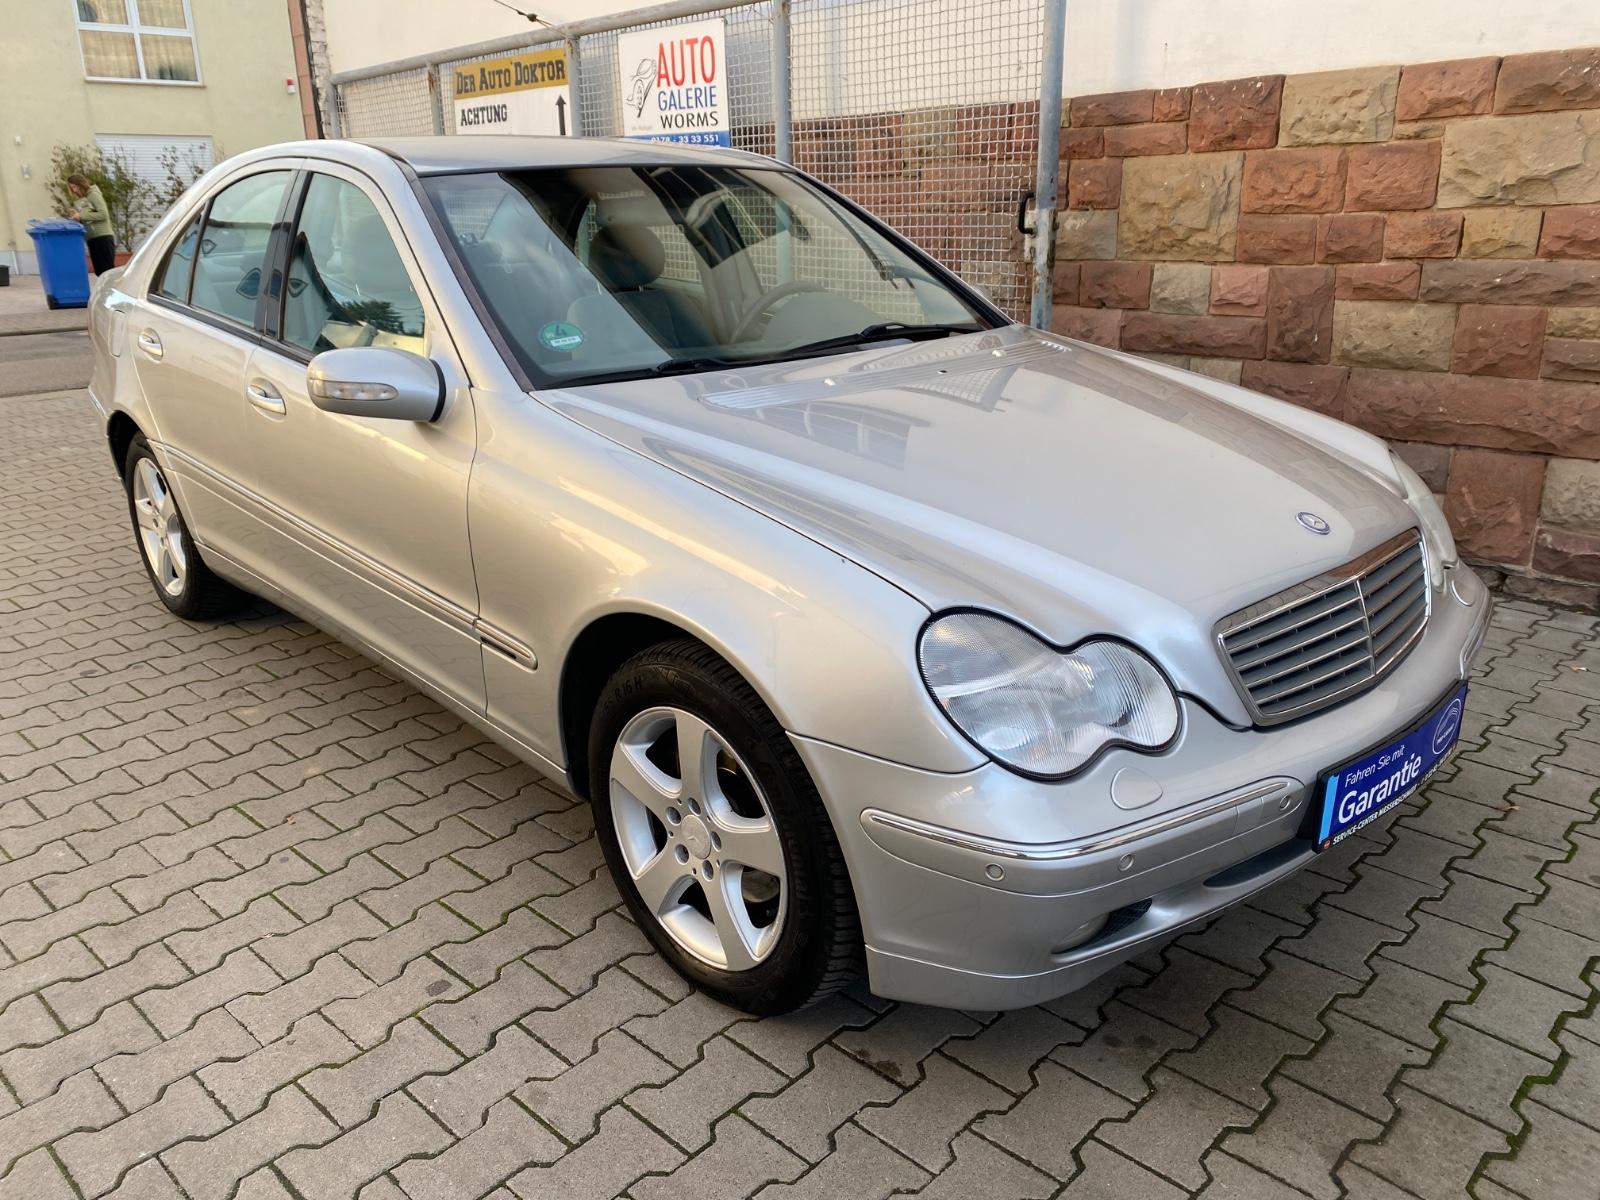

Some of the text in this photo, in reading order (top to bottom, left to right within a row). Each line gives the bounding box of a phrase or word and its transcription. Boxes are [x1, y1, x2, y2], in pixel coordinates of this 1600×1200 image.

[456, 59, 566, 95] DER AUTO DOKTOR
[656, 35, 716, 88] AUTO
[460, 104, 508, 127] ACHTUNG
[658, 86, 717, 112] GALERIE
[660, 111, 719, 129] WORMS
[678, 133, 689, 142] 33
[691, 133, 702, 142] 33
[703, 132, 719, 142] 551
[1345, 745, 1405, 788] Fahren Sie mit
[1338, 753, 1421, 824] Garantie
[1332, 811, 1379, 845] SERVICE-CENTER
